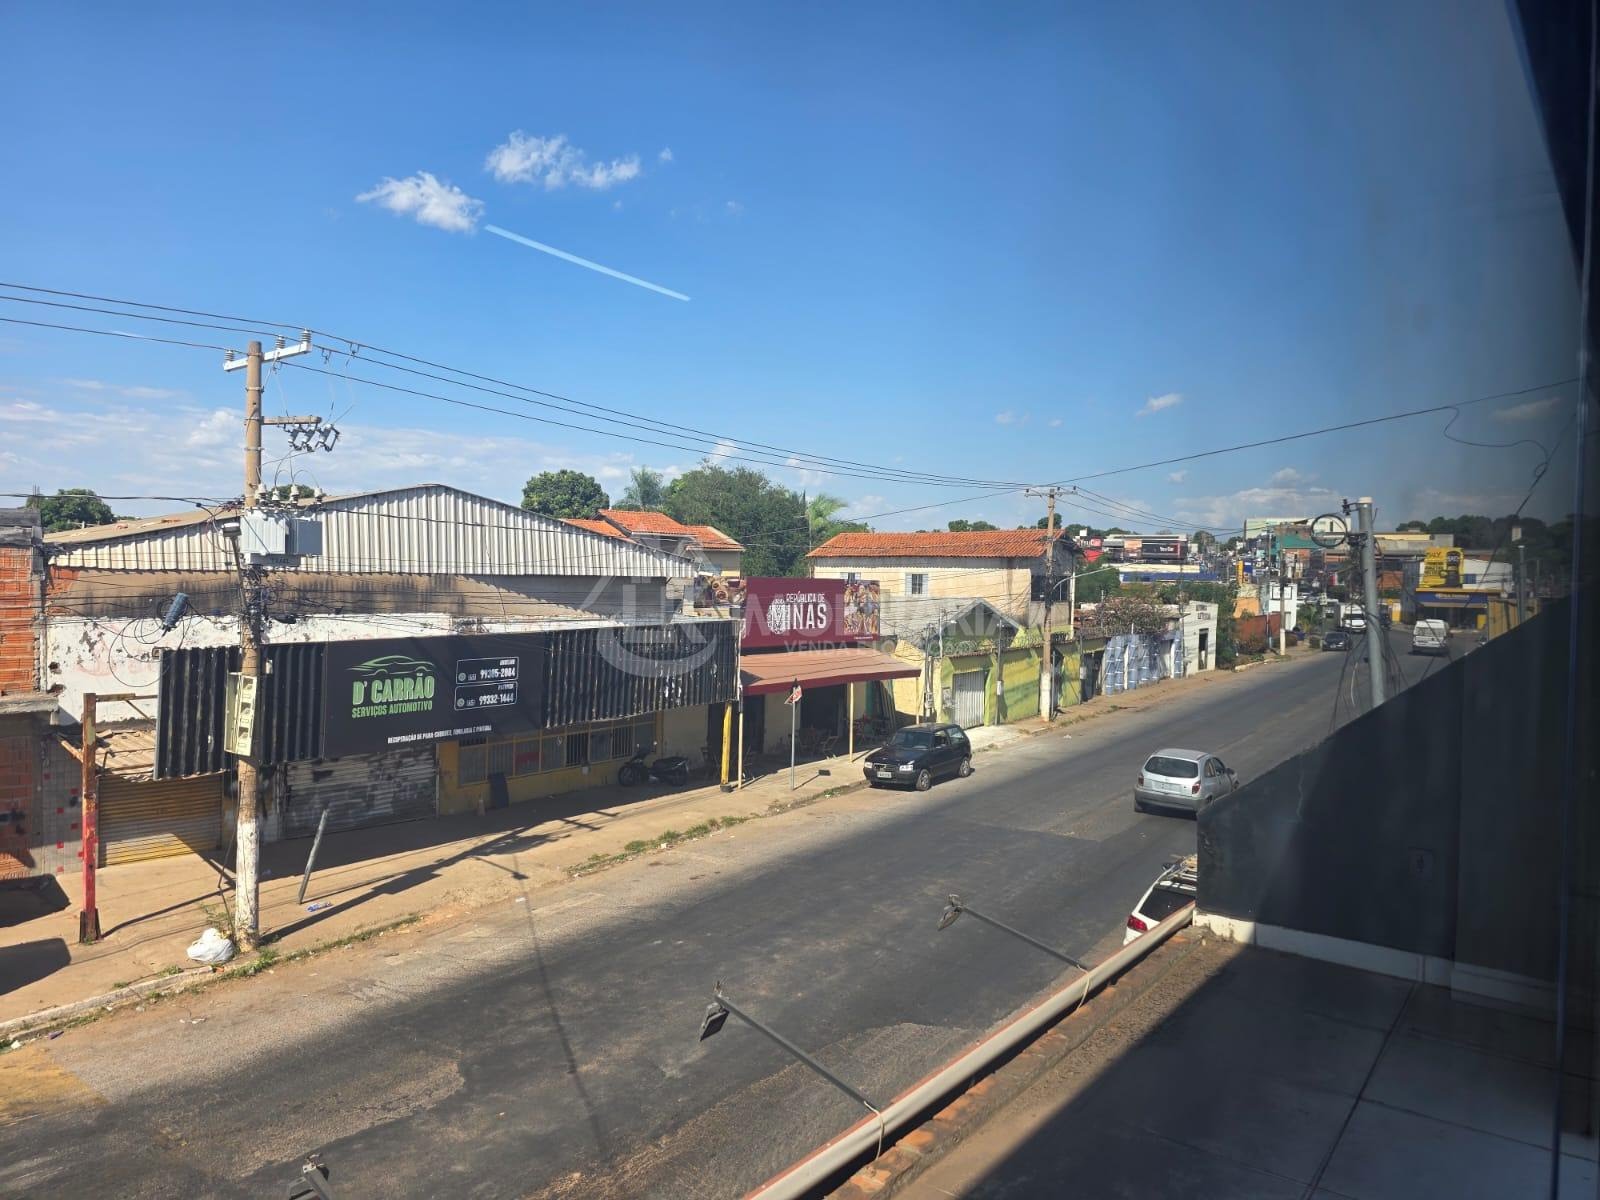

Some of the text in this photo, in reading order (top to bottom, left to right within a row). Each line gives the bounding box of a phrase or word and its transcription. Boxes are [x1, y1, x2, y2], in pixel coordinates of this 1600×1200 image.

[786, 591, 825, 603] REPÚBLICA DE
[770, 603, 827, 630] MINAS
[371, 673, 435, 704] CARRÃO
[352, 700, 433, 718] SERVIÇOS AUTOMOTIVO
